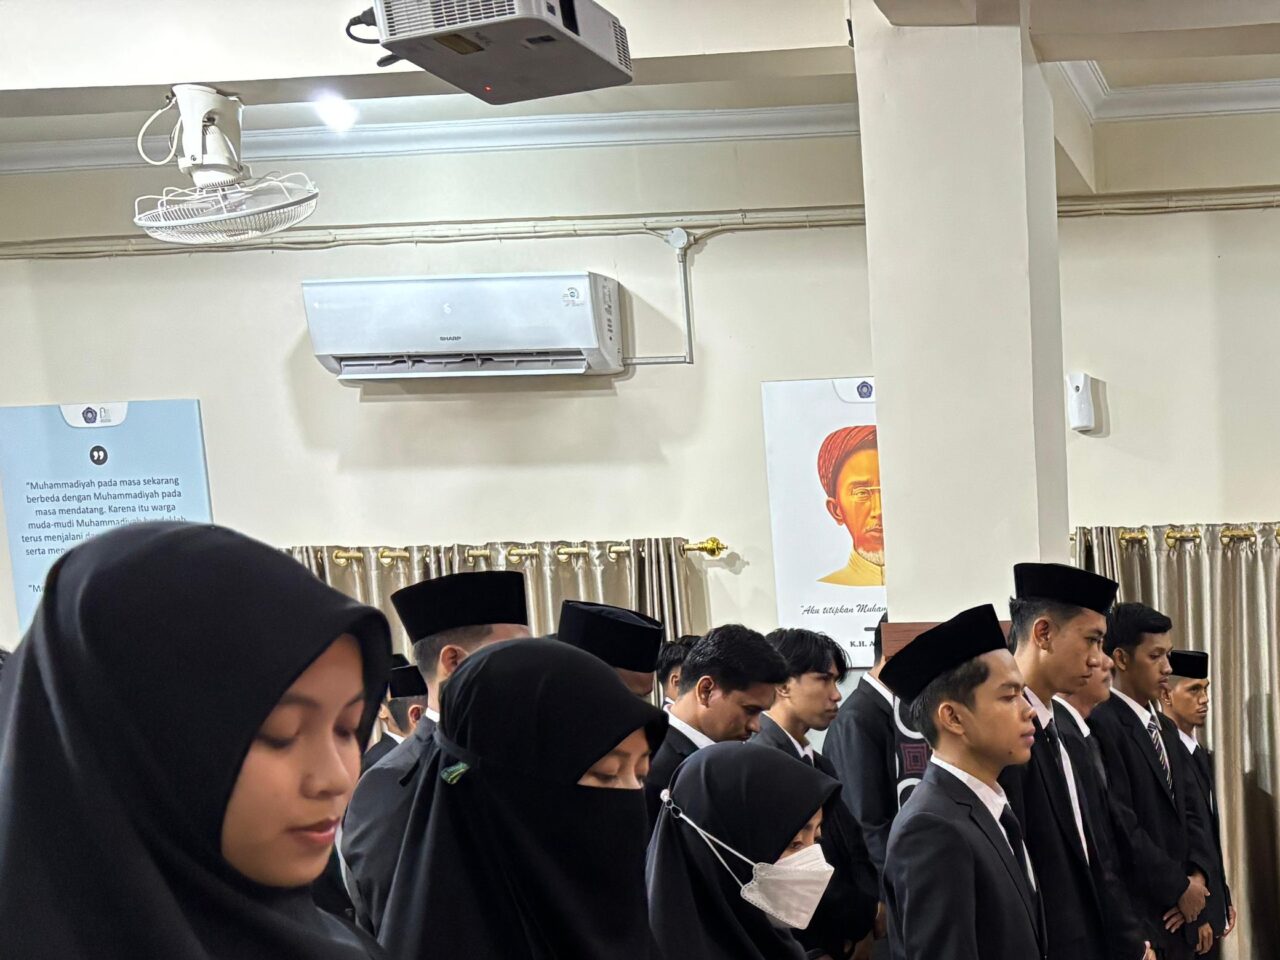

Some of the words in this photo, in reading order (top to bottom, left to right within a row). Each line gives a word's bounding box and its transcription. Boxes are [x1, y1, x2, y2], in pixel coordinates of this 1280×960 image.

[97, 479, 117, 488] pada
[143, 477, 180, 486] sekarang
[26, 494, 60, 503] berbeda
[62, 493, 91, 503] dengan
[93, 490, 160, 500] Muhammadiyah
[162, 489, 181, 499] pada
[35, 508, 57, 516] masa
[58, 505, 106, 515] mendatang.
[108, 504, 136, 513] Karena
[138, 504, 149, 512] itu
[151, 504, 176, 513] warga
[28, 519, 75, 529] muda-mudi
[21, 535, 42, 543] terus
[44, 532, 84, 542] menjalani
[823, 605, 854, 615] titipkan
